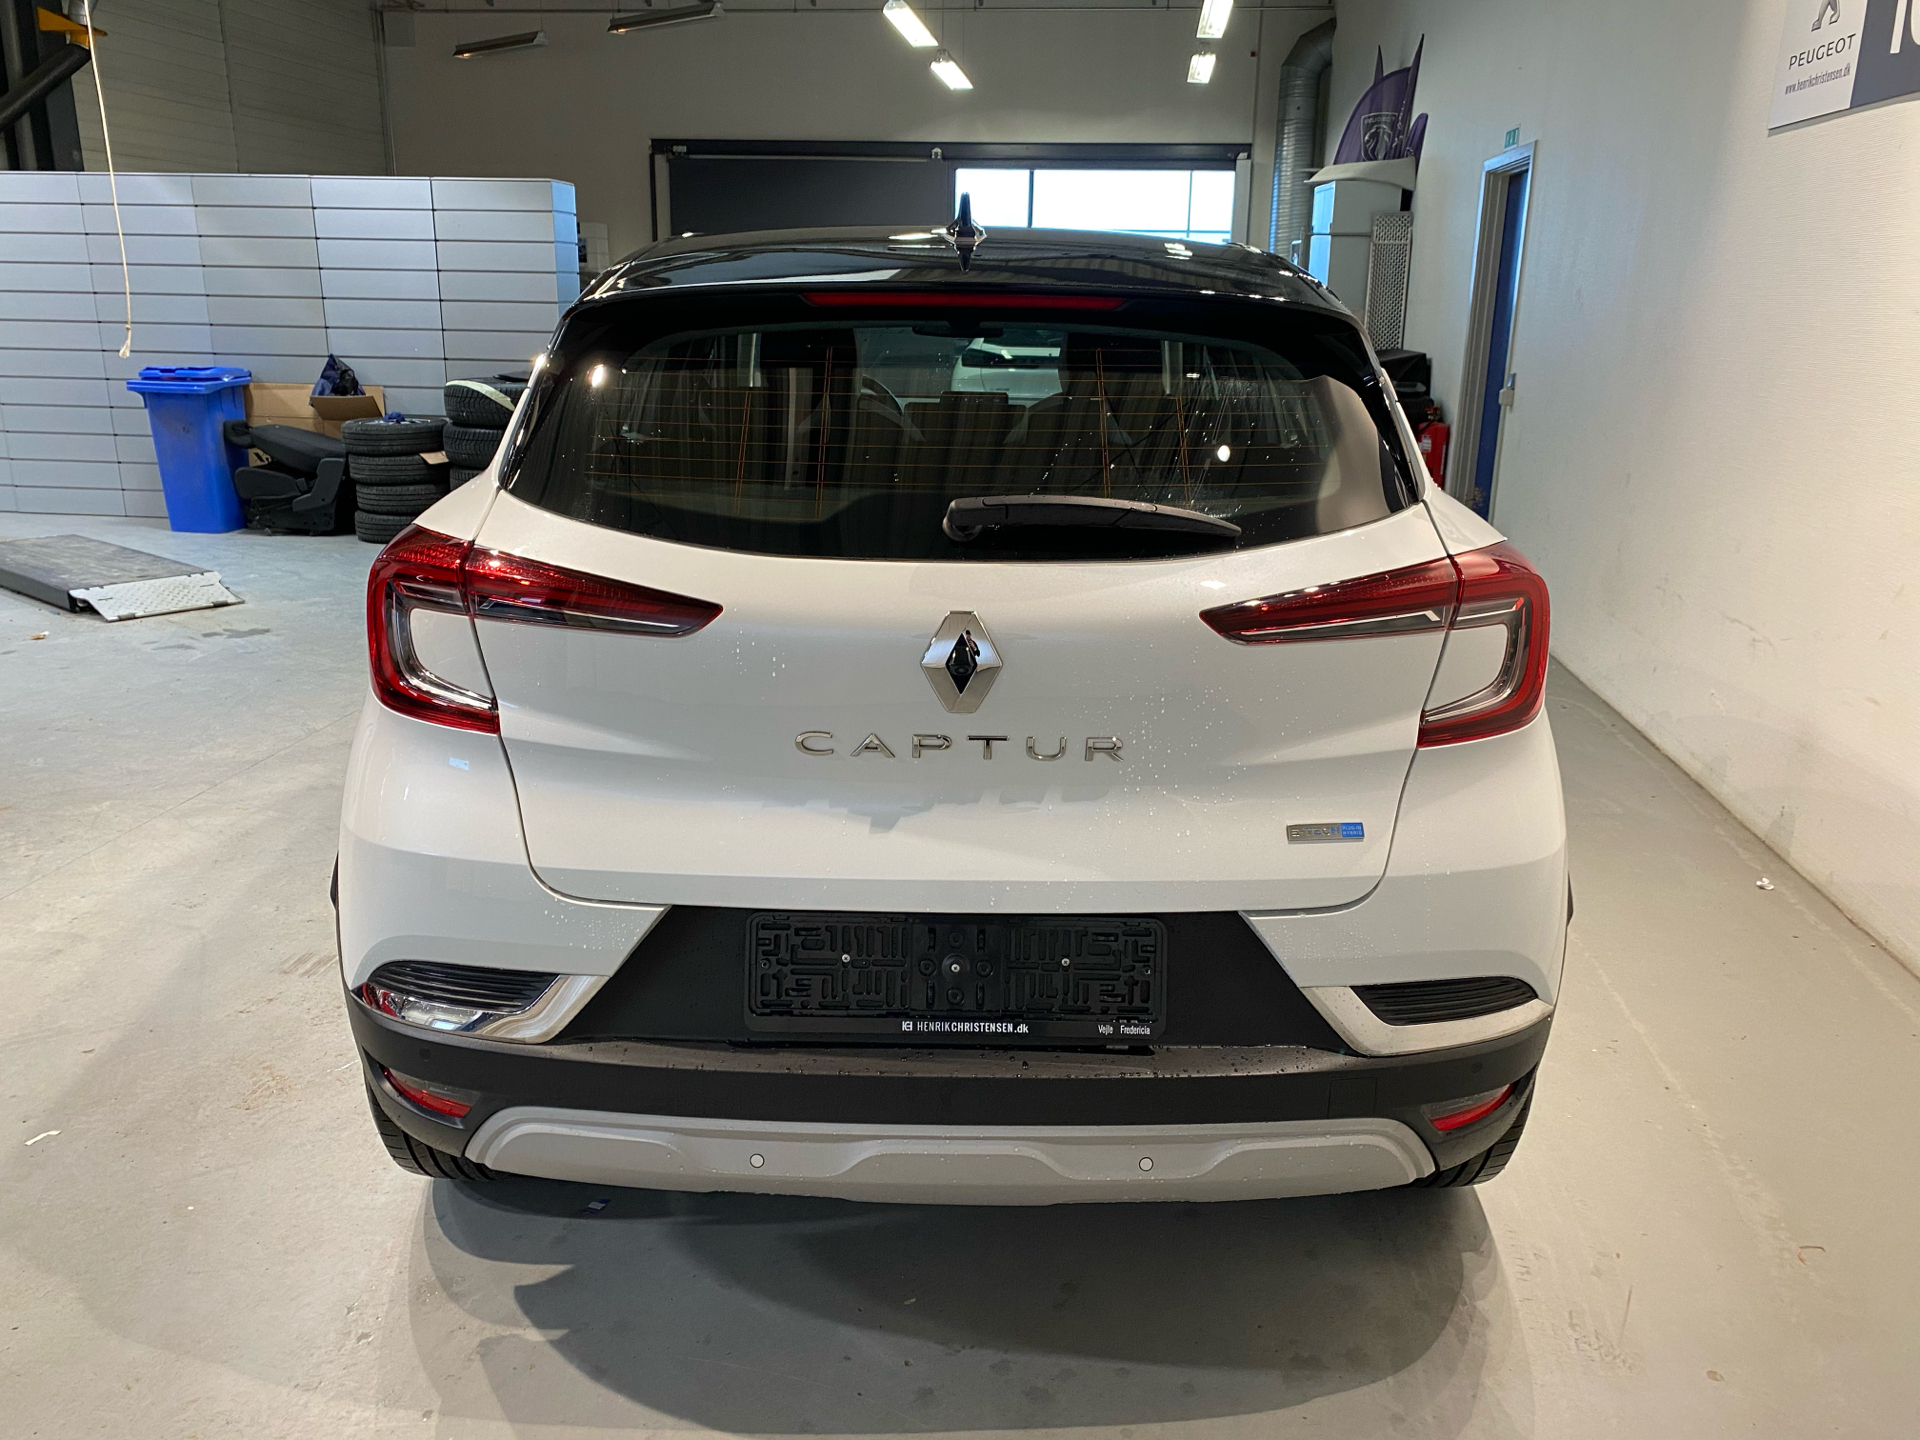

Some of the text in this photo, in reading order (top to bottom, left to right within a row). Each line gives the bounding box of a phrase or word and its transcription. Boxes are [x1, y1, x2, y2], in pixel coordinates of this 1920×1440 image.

[1788, 33, 1856, 70] PEUGEOT
[1784, 63, 1852, 95] www.henrikchristensen.dk
[794, 730, 1124, 762] CAPTUR
[917, 1021, 1029, 1034] HENRIKCHRISTENSEN.dk
[1097, 1024, 1151, 1036] Vejle Fredericia
